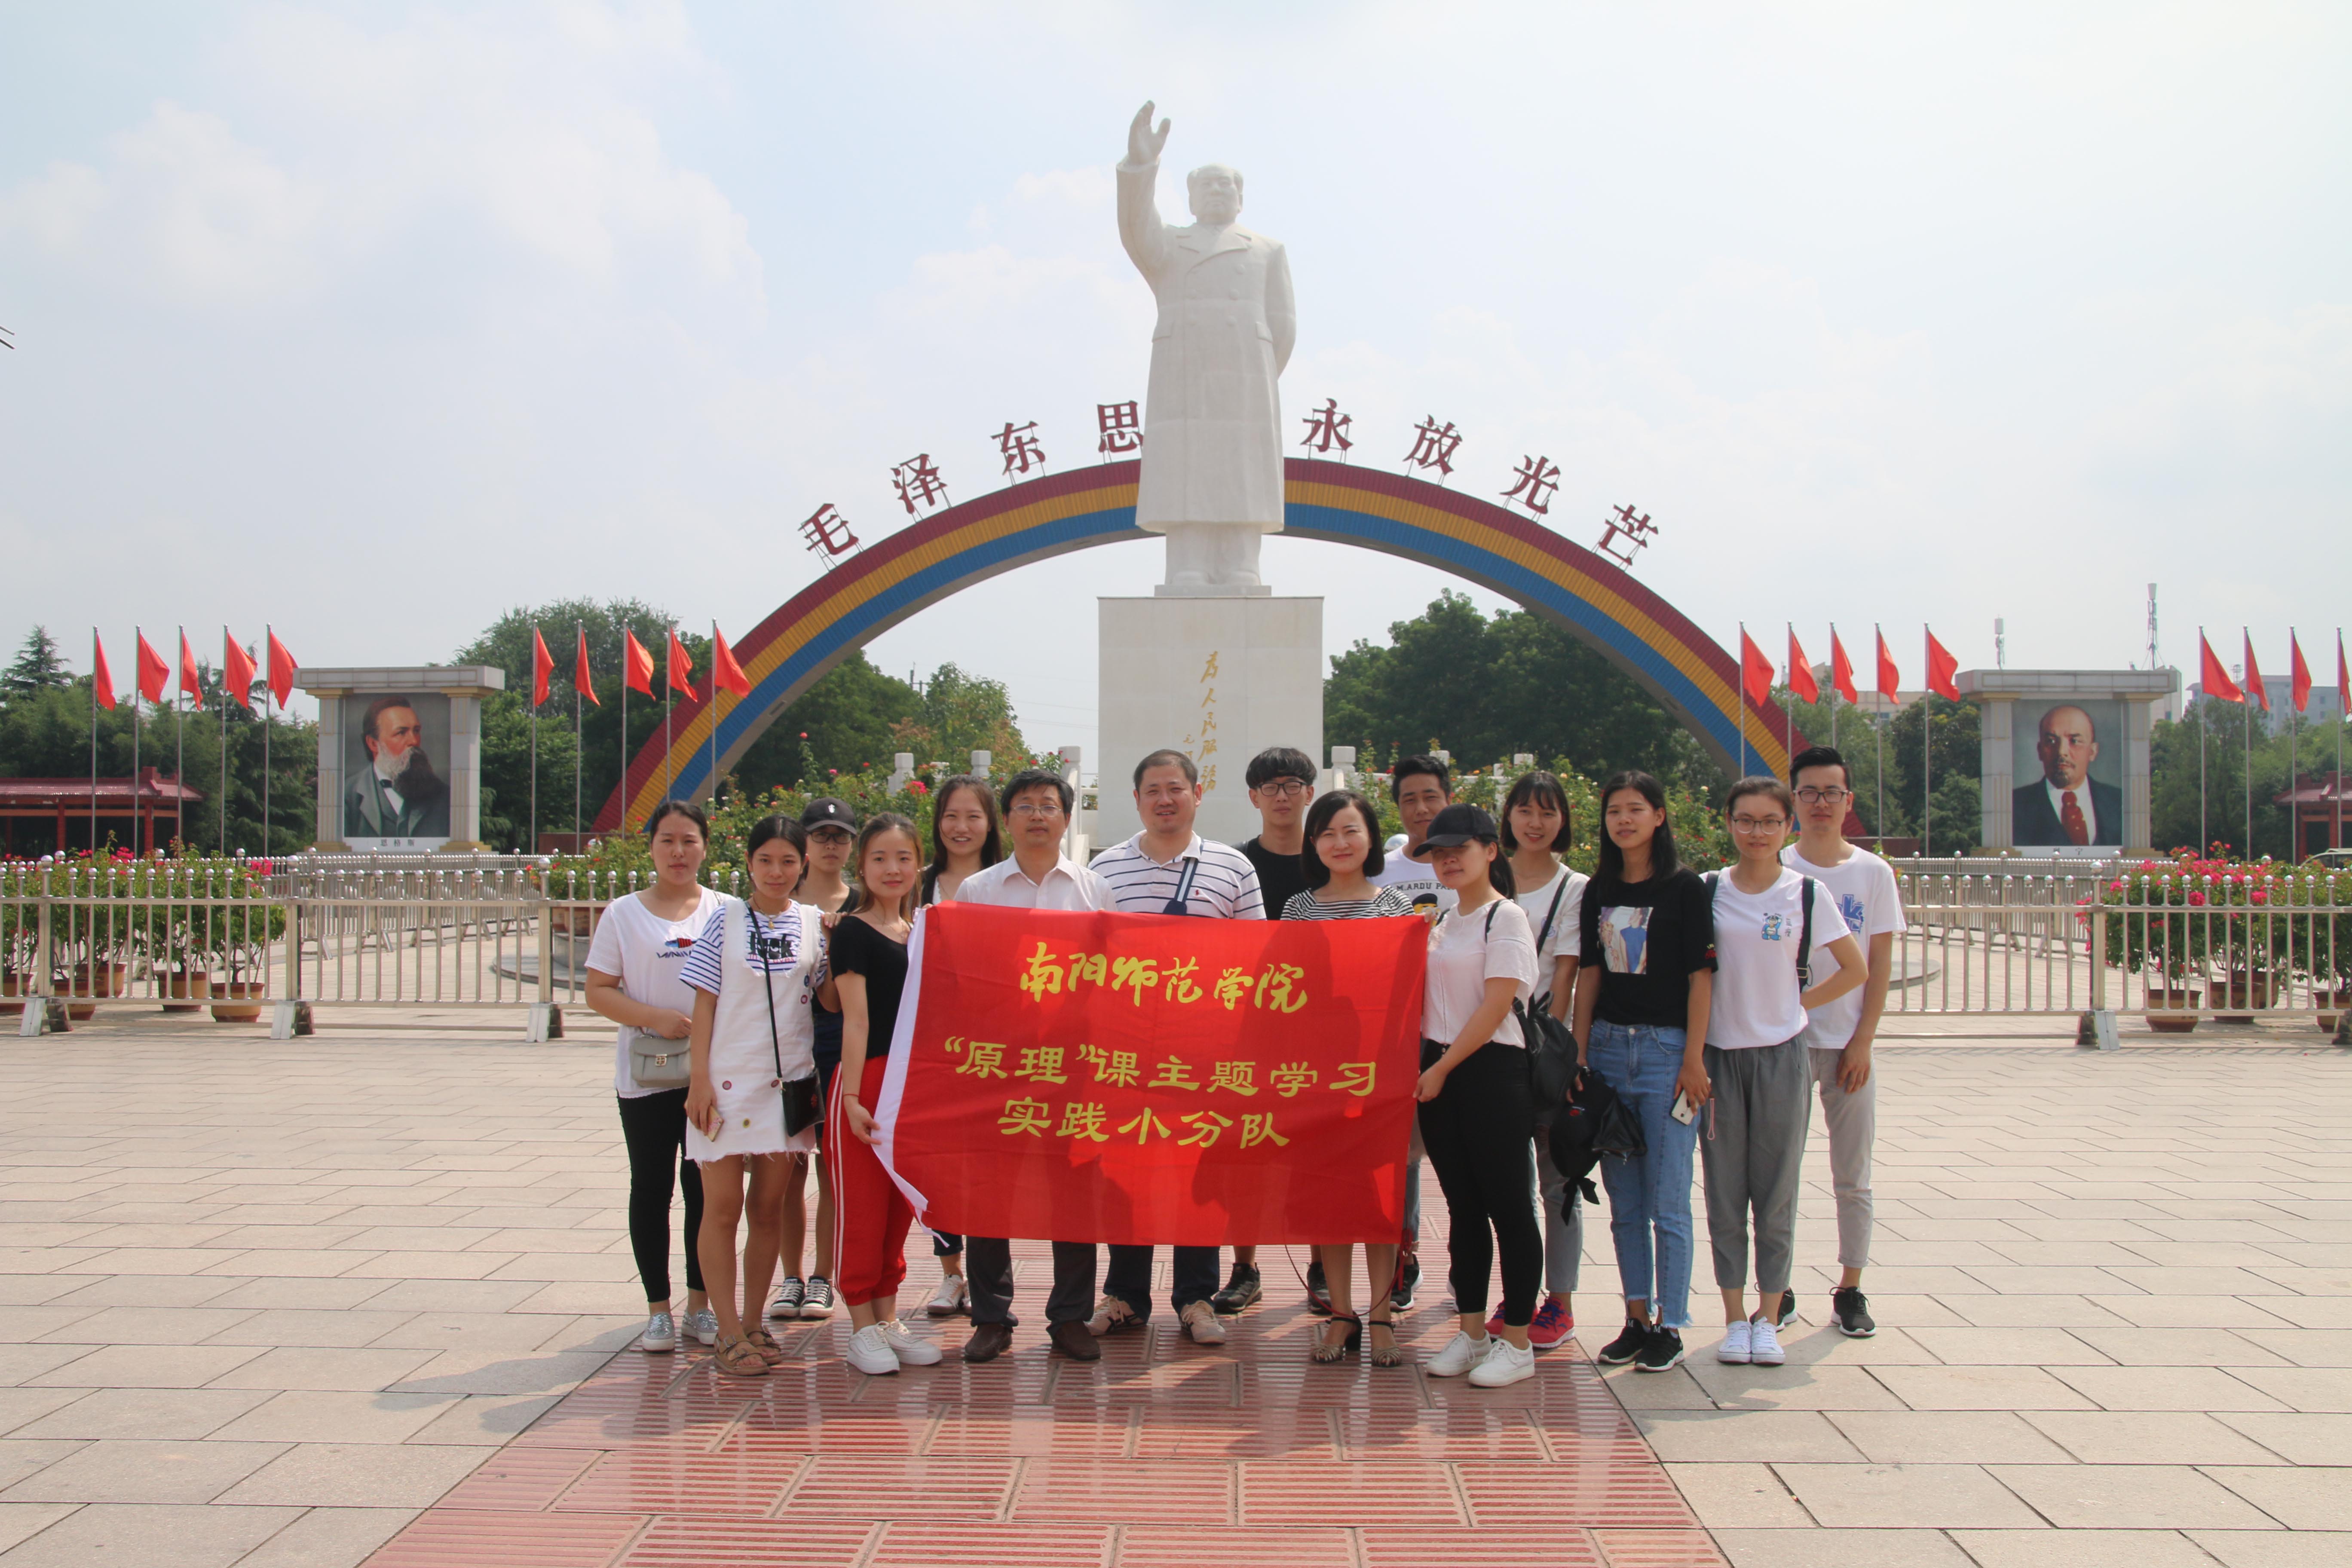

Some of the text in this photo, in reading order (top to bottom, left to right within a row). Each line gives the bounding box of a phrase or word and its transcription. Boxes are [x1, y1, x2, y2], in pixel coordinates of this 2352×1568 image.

[1020, 942, 1308, 1013] 南阳师范学院
[997, 1096, 1289, 1149] 实践小分队
